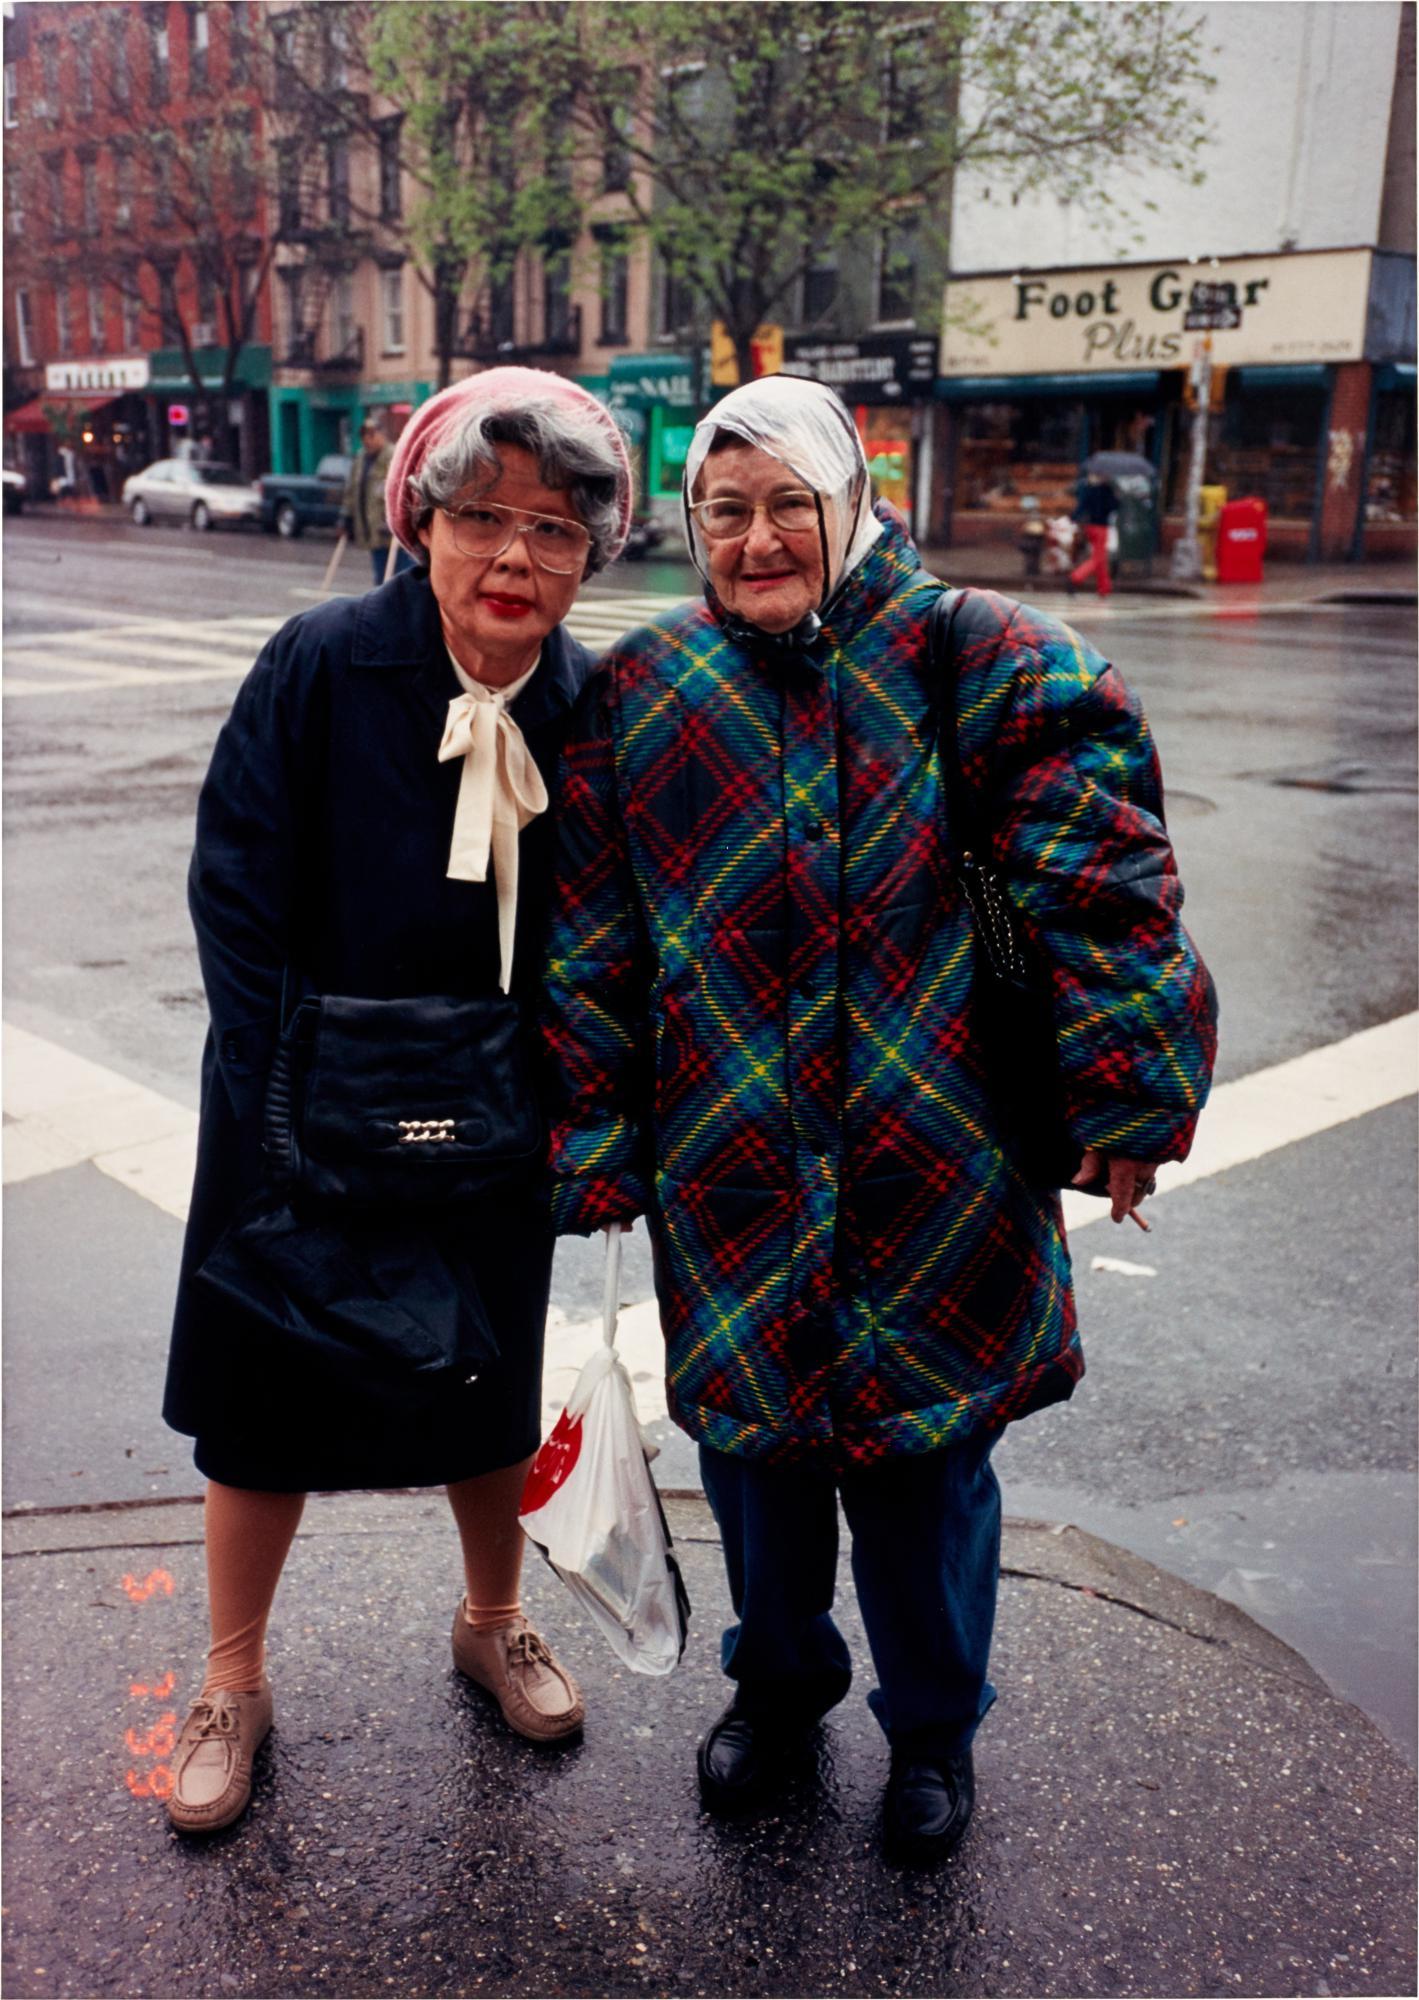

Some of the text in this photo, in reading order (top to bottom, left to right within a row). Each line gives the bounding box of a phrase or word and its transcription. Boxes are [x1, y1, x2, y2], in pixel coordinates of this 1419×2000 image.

[1013, 279, 1119, 320] Foot
[1149, 269, 1269, 311] Gar
[1083, 319, 1183, 363] Plus
